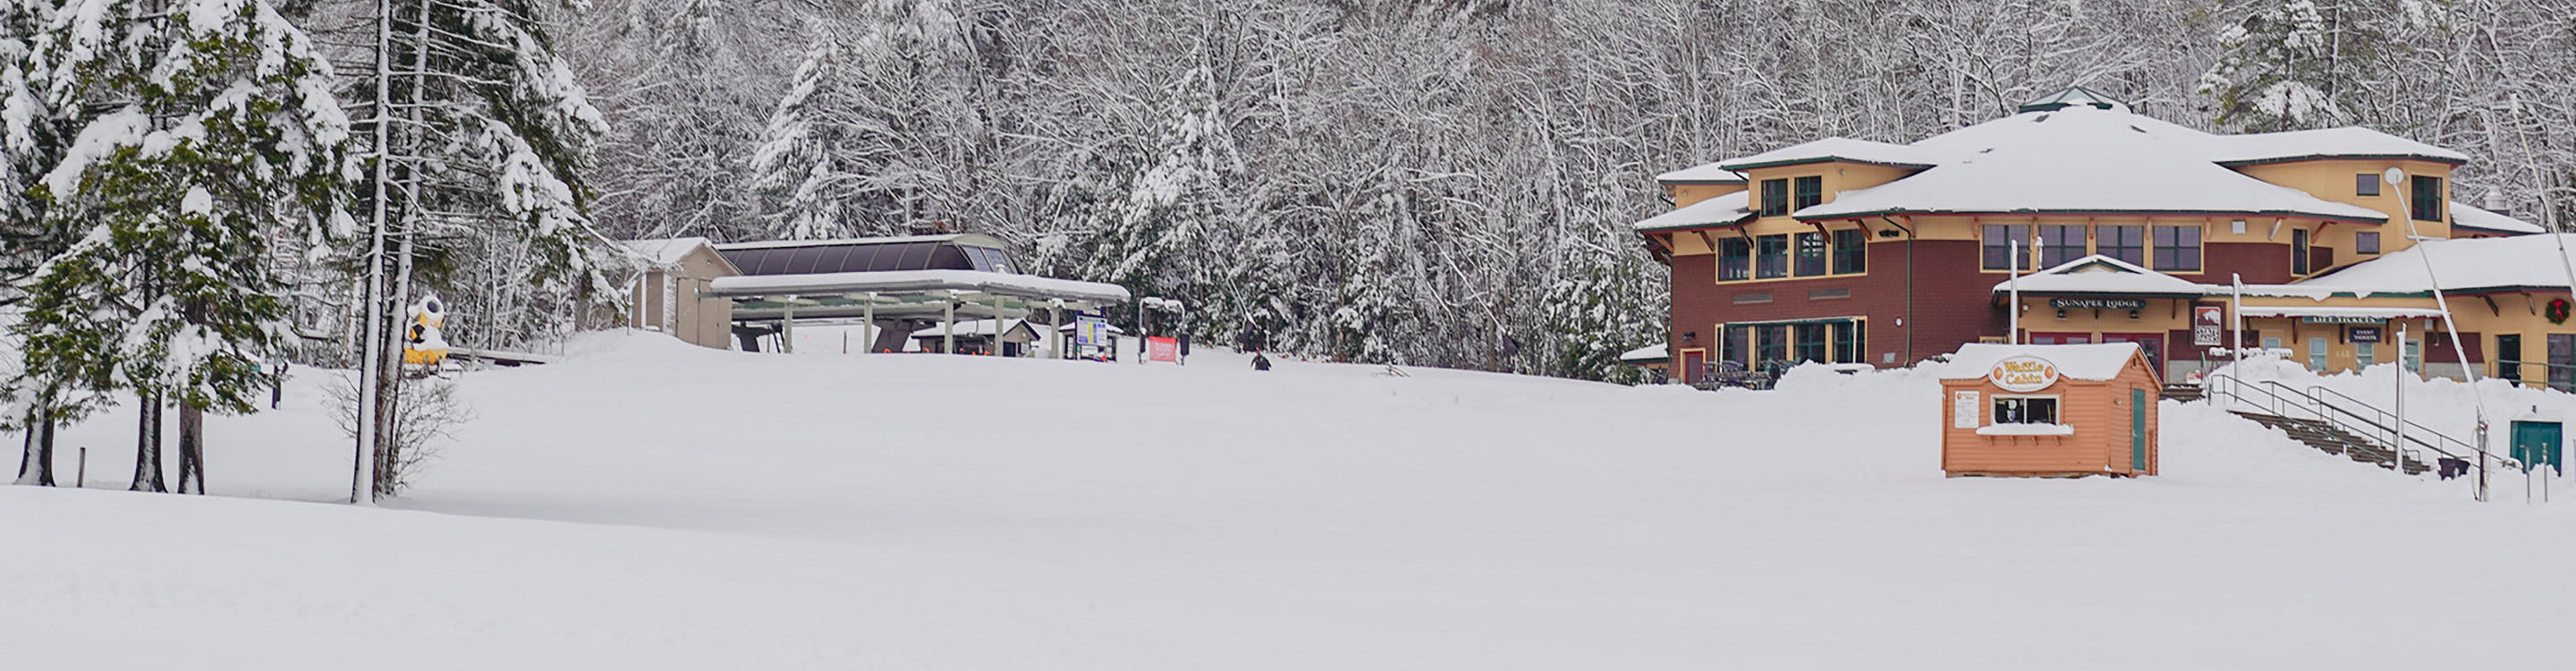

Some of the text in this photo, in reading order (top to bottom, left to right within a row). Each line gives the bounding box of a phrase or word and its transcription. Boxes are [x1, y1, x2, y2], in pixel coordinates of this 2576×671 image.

[2057, 299, 2140, 309] SUNAPEE LODGE
[2004, 361, 2044, 372] Waffle
[2005, 373, 2043, 385] Cabin
